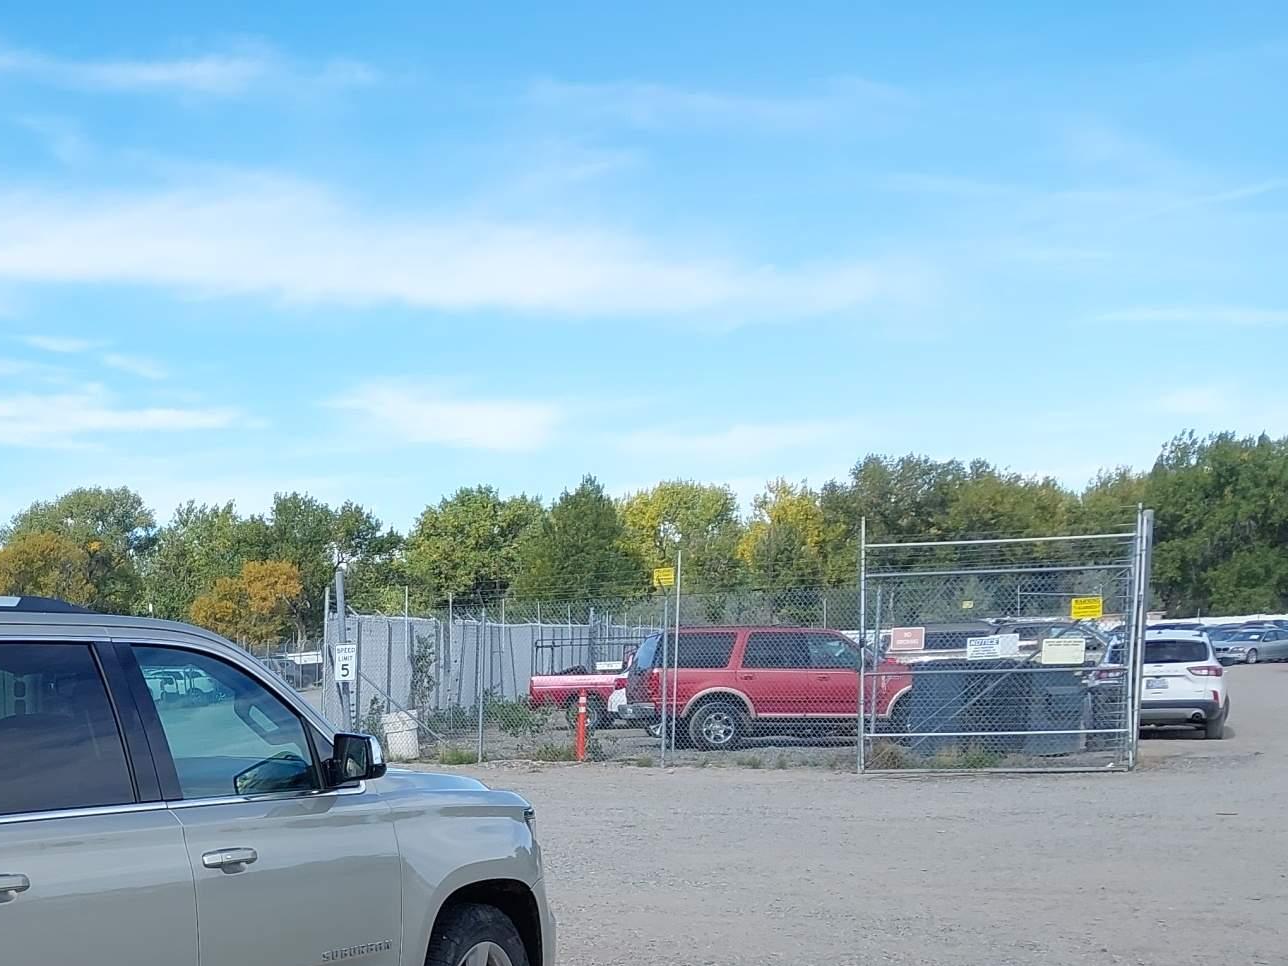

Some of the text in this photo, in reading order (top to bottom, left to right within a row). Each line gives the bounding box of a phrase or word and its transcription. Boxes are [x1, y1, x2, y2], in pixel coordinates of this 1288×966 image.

[969, 638, 999, 646] NOTICE
[341, 663, 350, 677] 5
[321, 939, 393, 961] SUBURBAN
